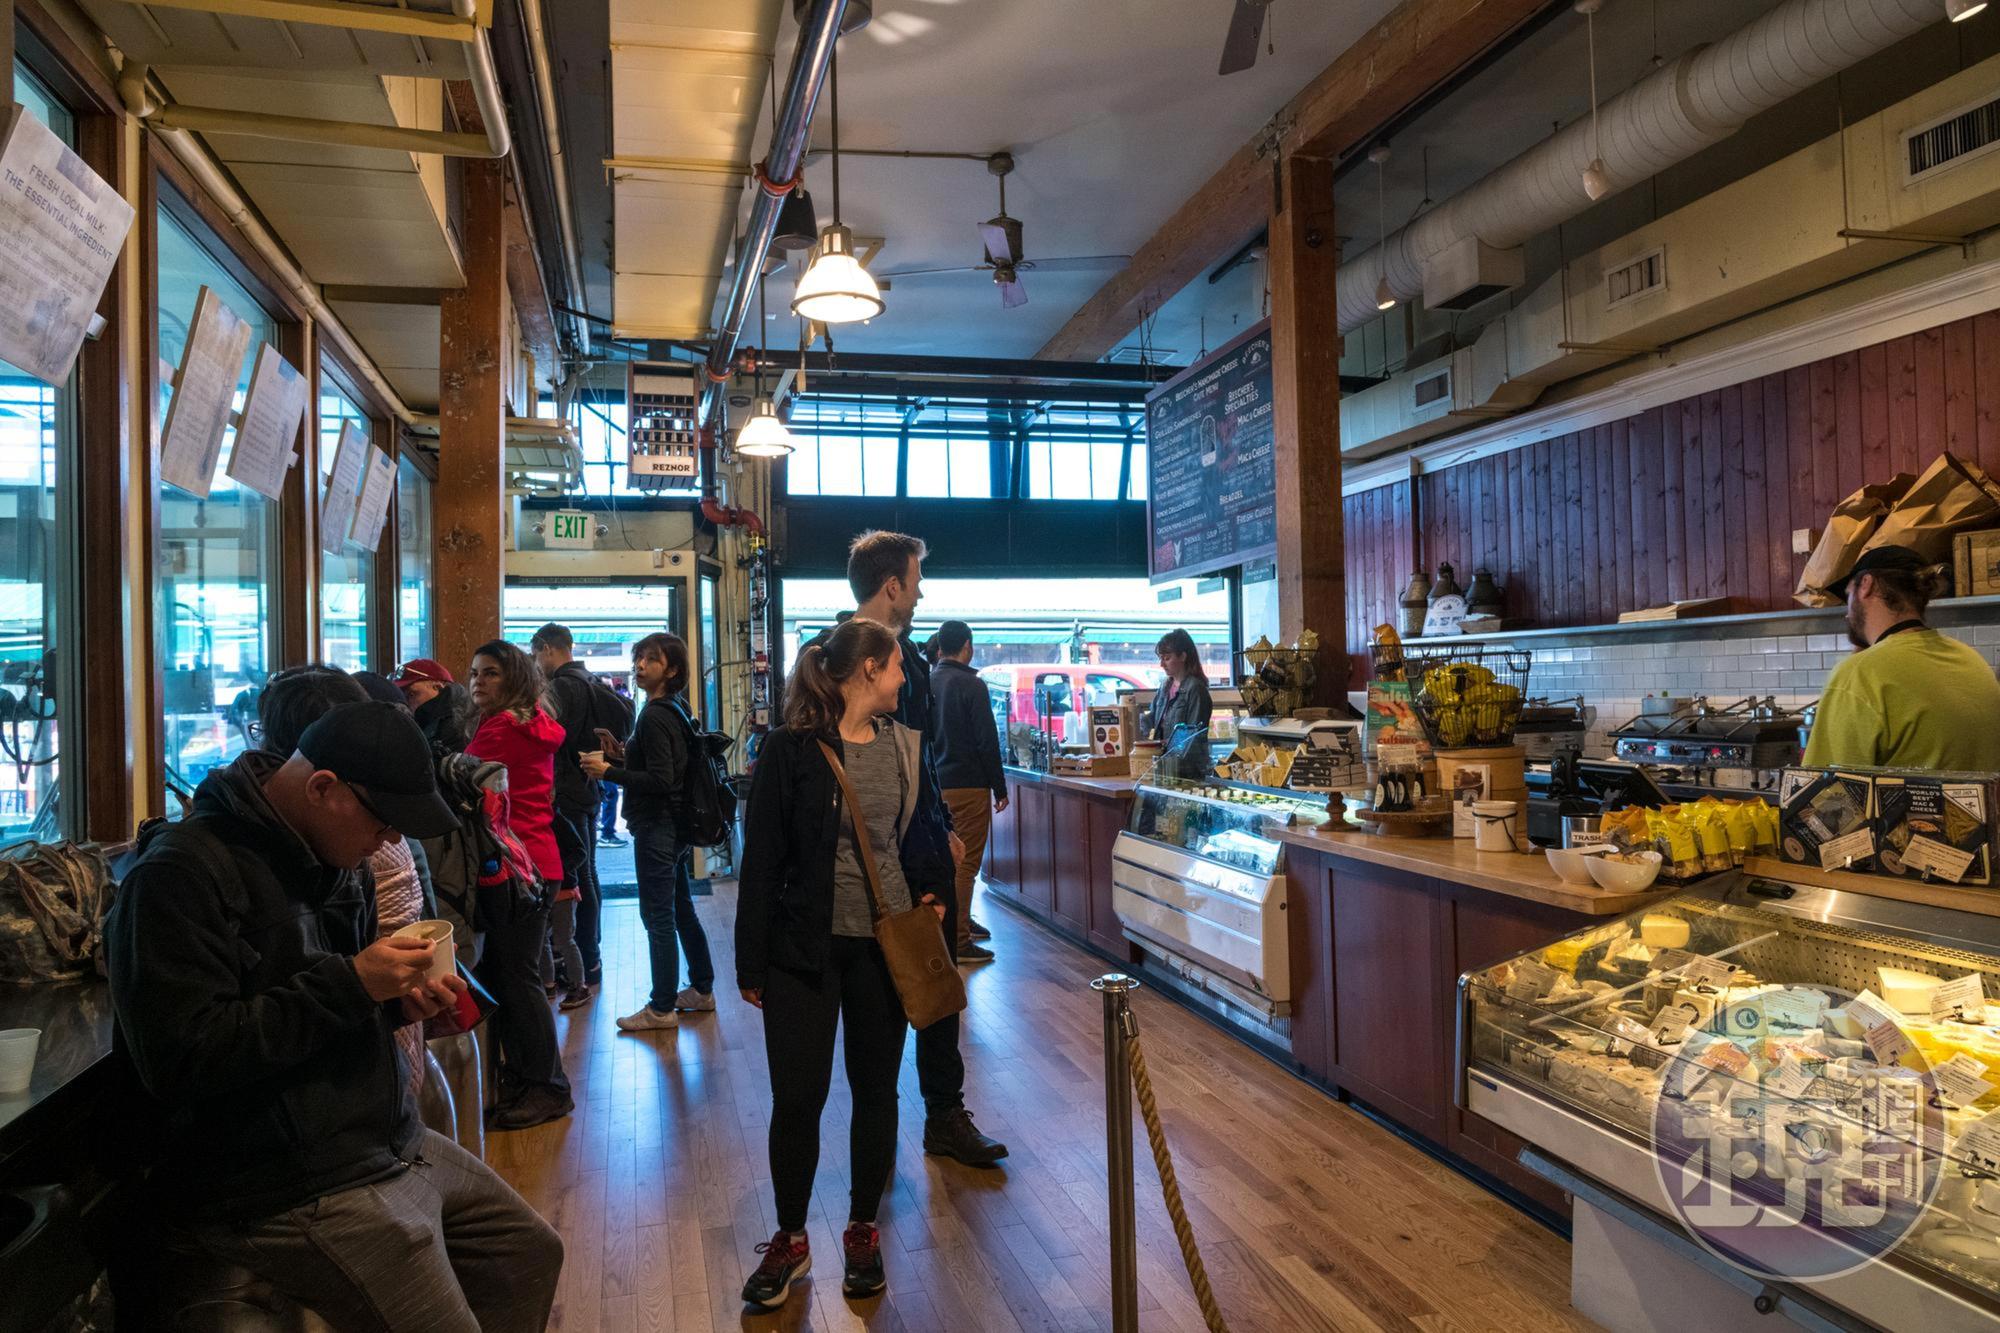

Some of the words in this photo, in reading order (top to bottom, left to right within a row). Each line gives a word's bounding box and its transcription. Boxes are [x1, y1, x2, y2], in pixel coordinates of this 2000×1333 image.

[29, 165, 60, 195] FRESH
[60, 190, 84, 218] LOCAL
[86, 211, 107, 236] MILK:
[4, 168, 24, 192] THE
[25, 186, 68, 229] ESSENTIAL
[69, 221, 113, 261] INGREDIENT
[1221, 358, 1238, 374] CHEESE
[1228, 381, 1254, 402] BEECHER'S
[1252, 402, 1271, 417] CHEESE
[1252, 443, 1270, 458] CHEESE
[652, 463, 690, 472] REZNOR
[554, 515, 588, 538] EXIT
[1377, 735, 1418, 745] culture
[1573, 834, 1601, 842] TRASH
